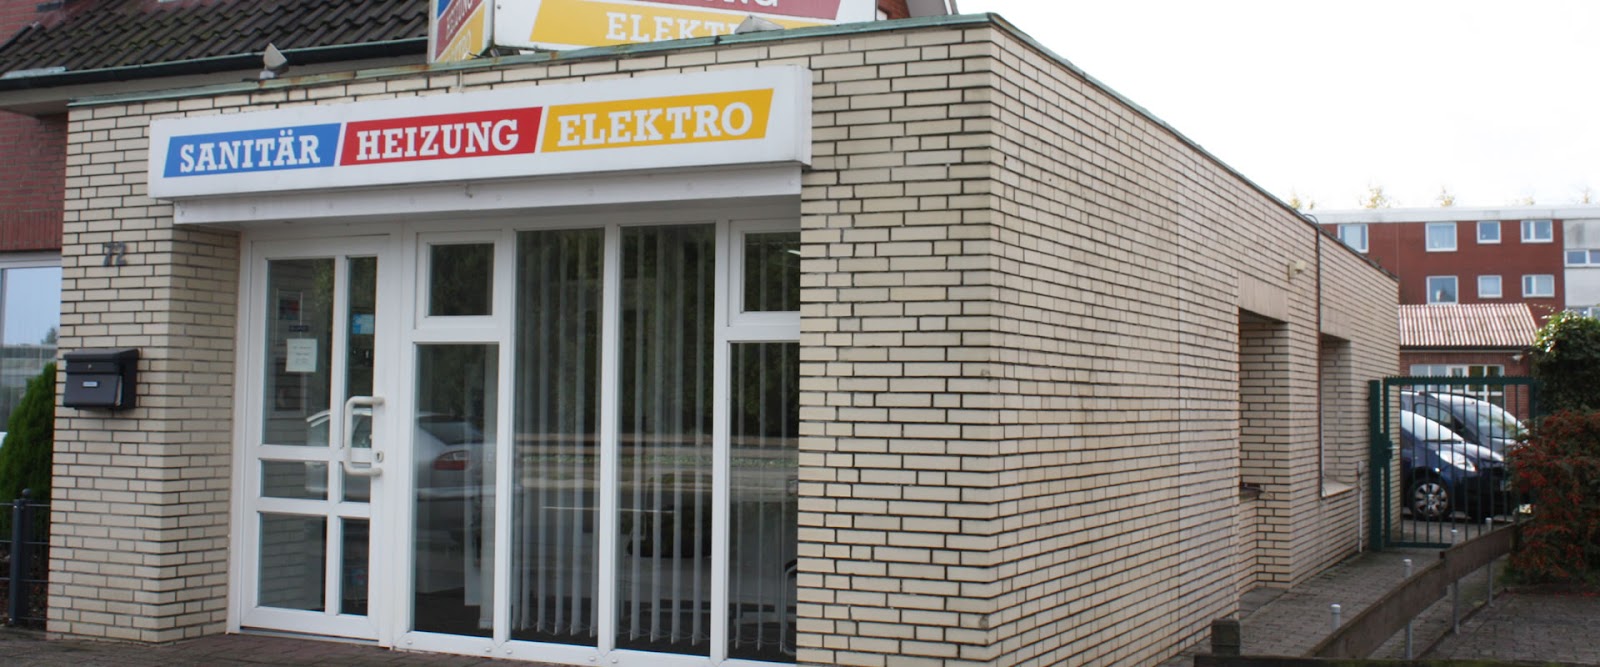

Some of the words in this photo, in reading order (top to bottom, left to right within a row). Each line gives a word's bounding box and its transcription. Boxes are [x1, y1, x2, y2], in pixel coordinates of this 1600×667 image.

[180, 129, 321, 173] SANITÄR
[356, 119, 519, 161] HEIZUNG
[557, 101, 753, 147] ELEKTRO
[103, 241, 127, 267] 72
